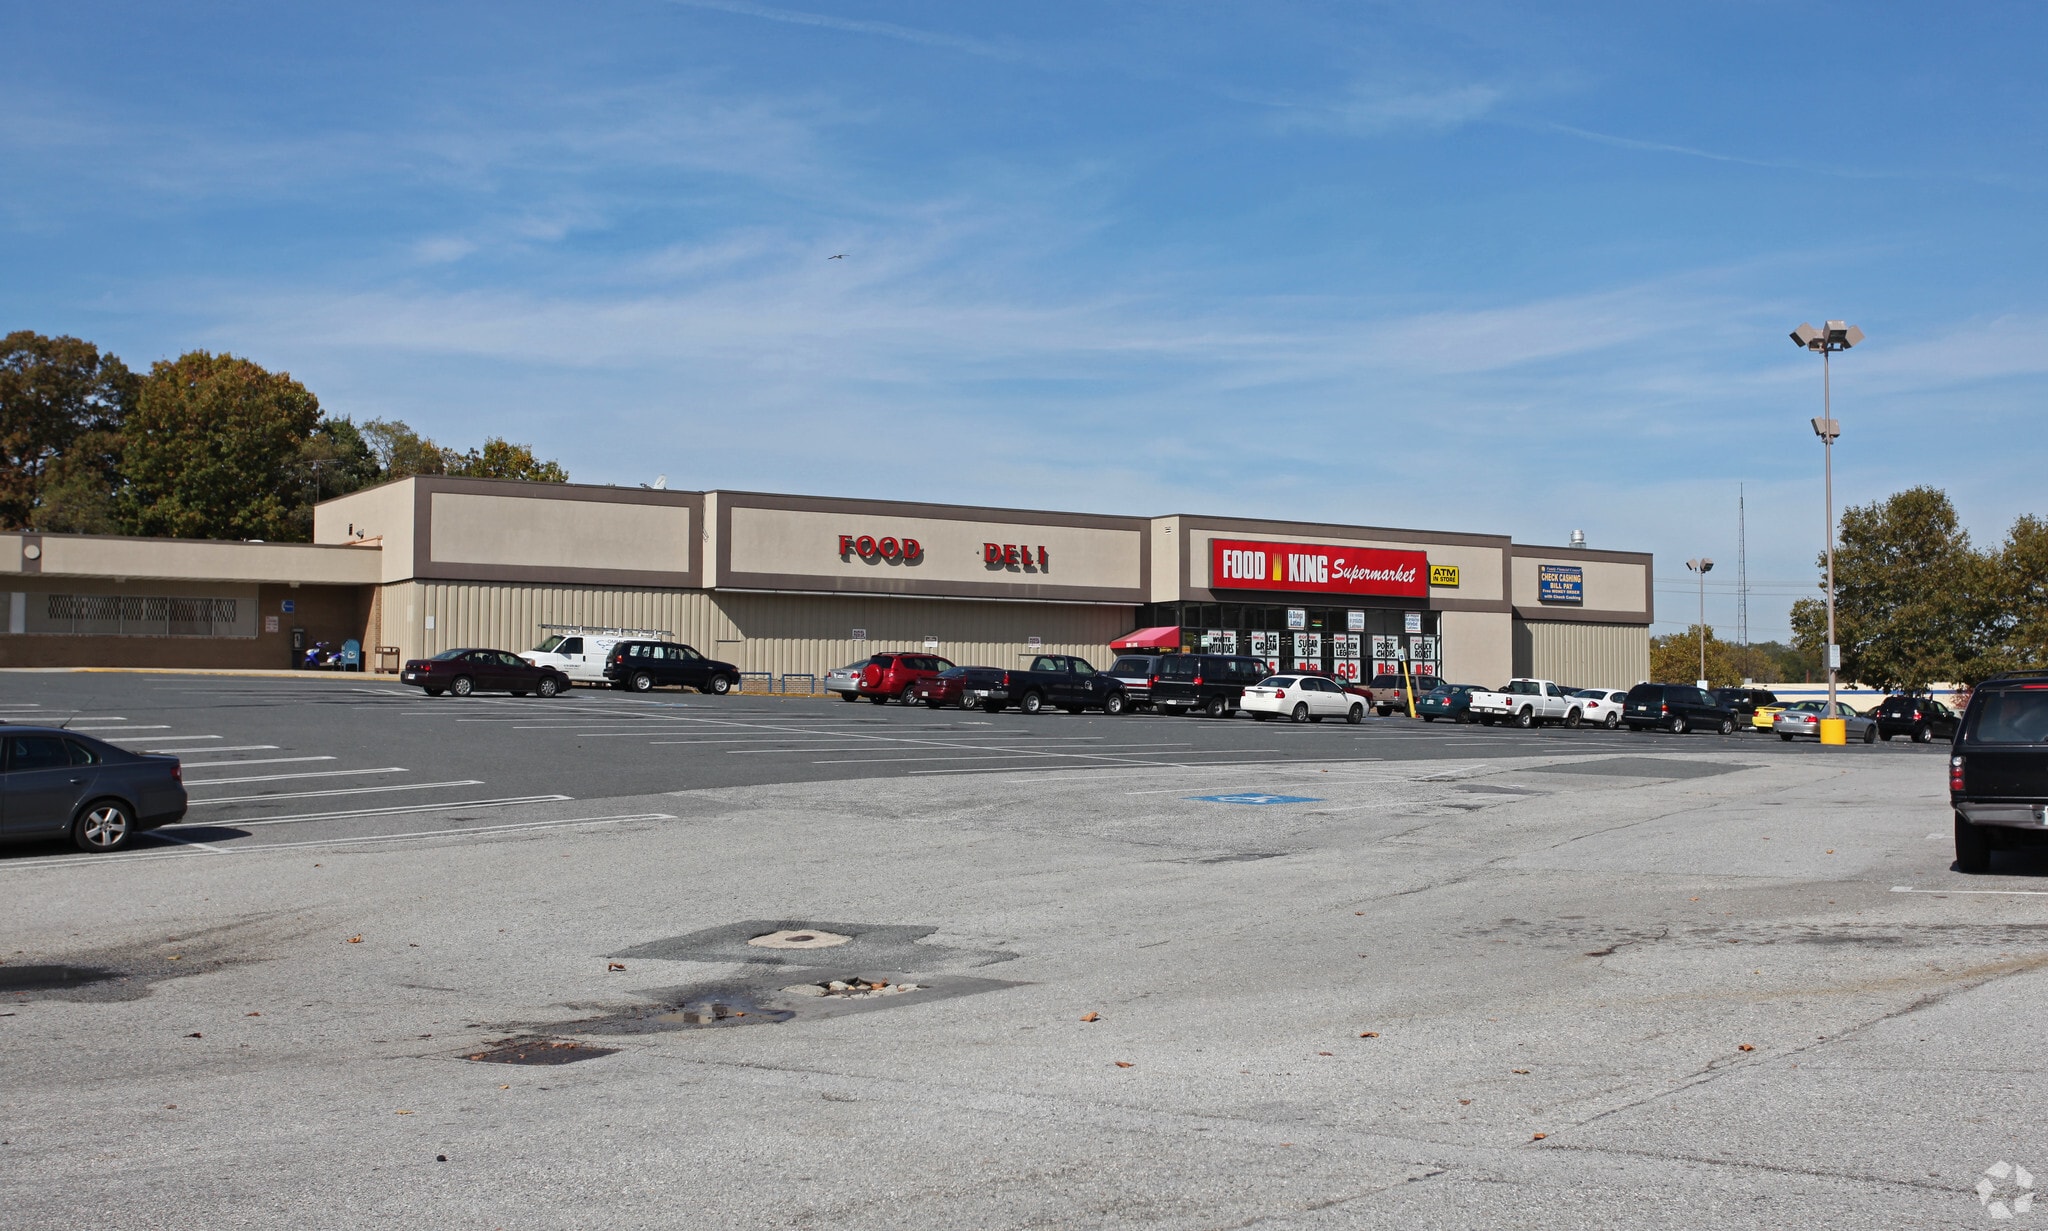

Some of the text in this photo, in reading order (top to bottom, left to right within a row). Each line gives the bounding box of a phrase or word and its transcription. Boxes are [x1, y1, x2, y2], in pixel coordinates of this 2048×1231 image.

[838, 535, 1046, 565] FOOD DELI
[1223, 549, 1416, 584] FOOD KING Supermarket
[1433, 568, 1456, 577] ATM
[1542, 573, 1581, 583] CHECK CASHING
[1208, 643, 1235, 654] POTATOES
[1255, 641, 1277, 651] CREAM
[1298, 639, 1318, 648] SUGAR
[1376, 641, 1394, 650] PORK
[1376, 650, 1396, 658] CHOPS
